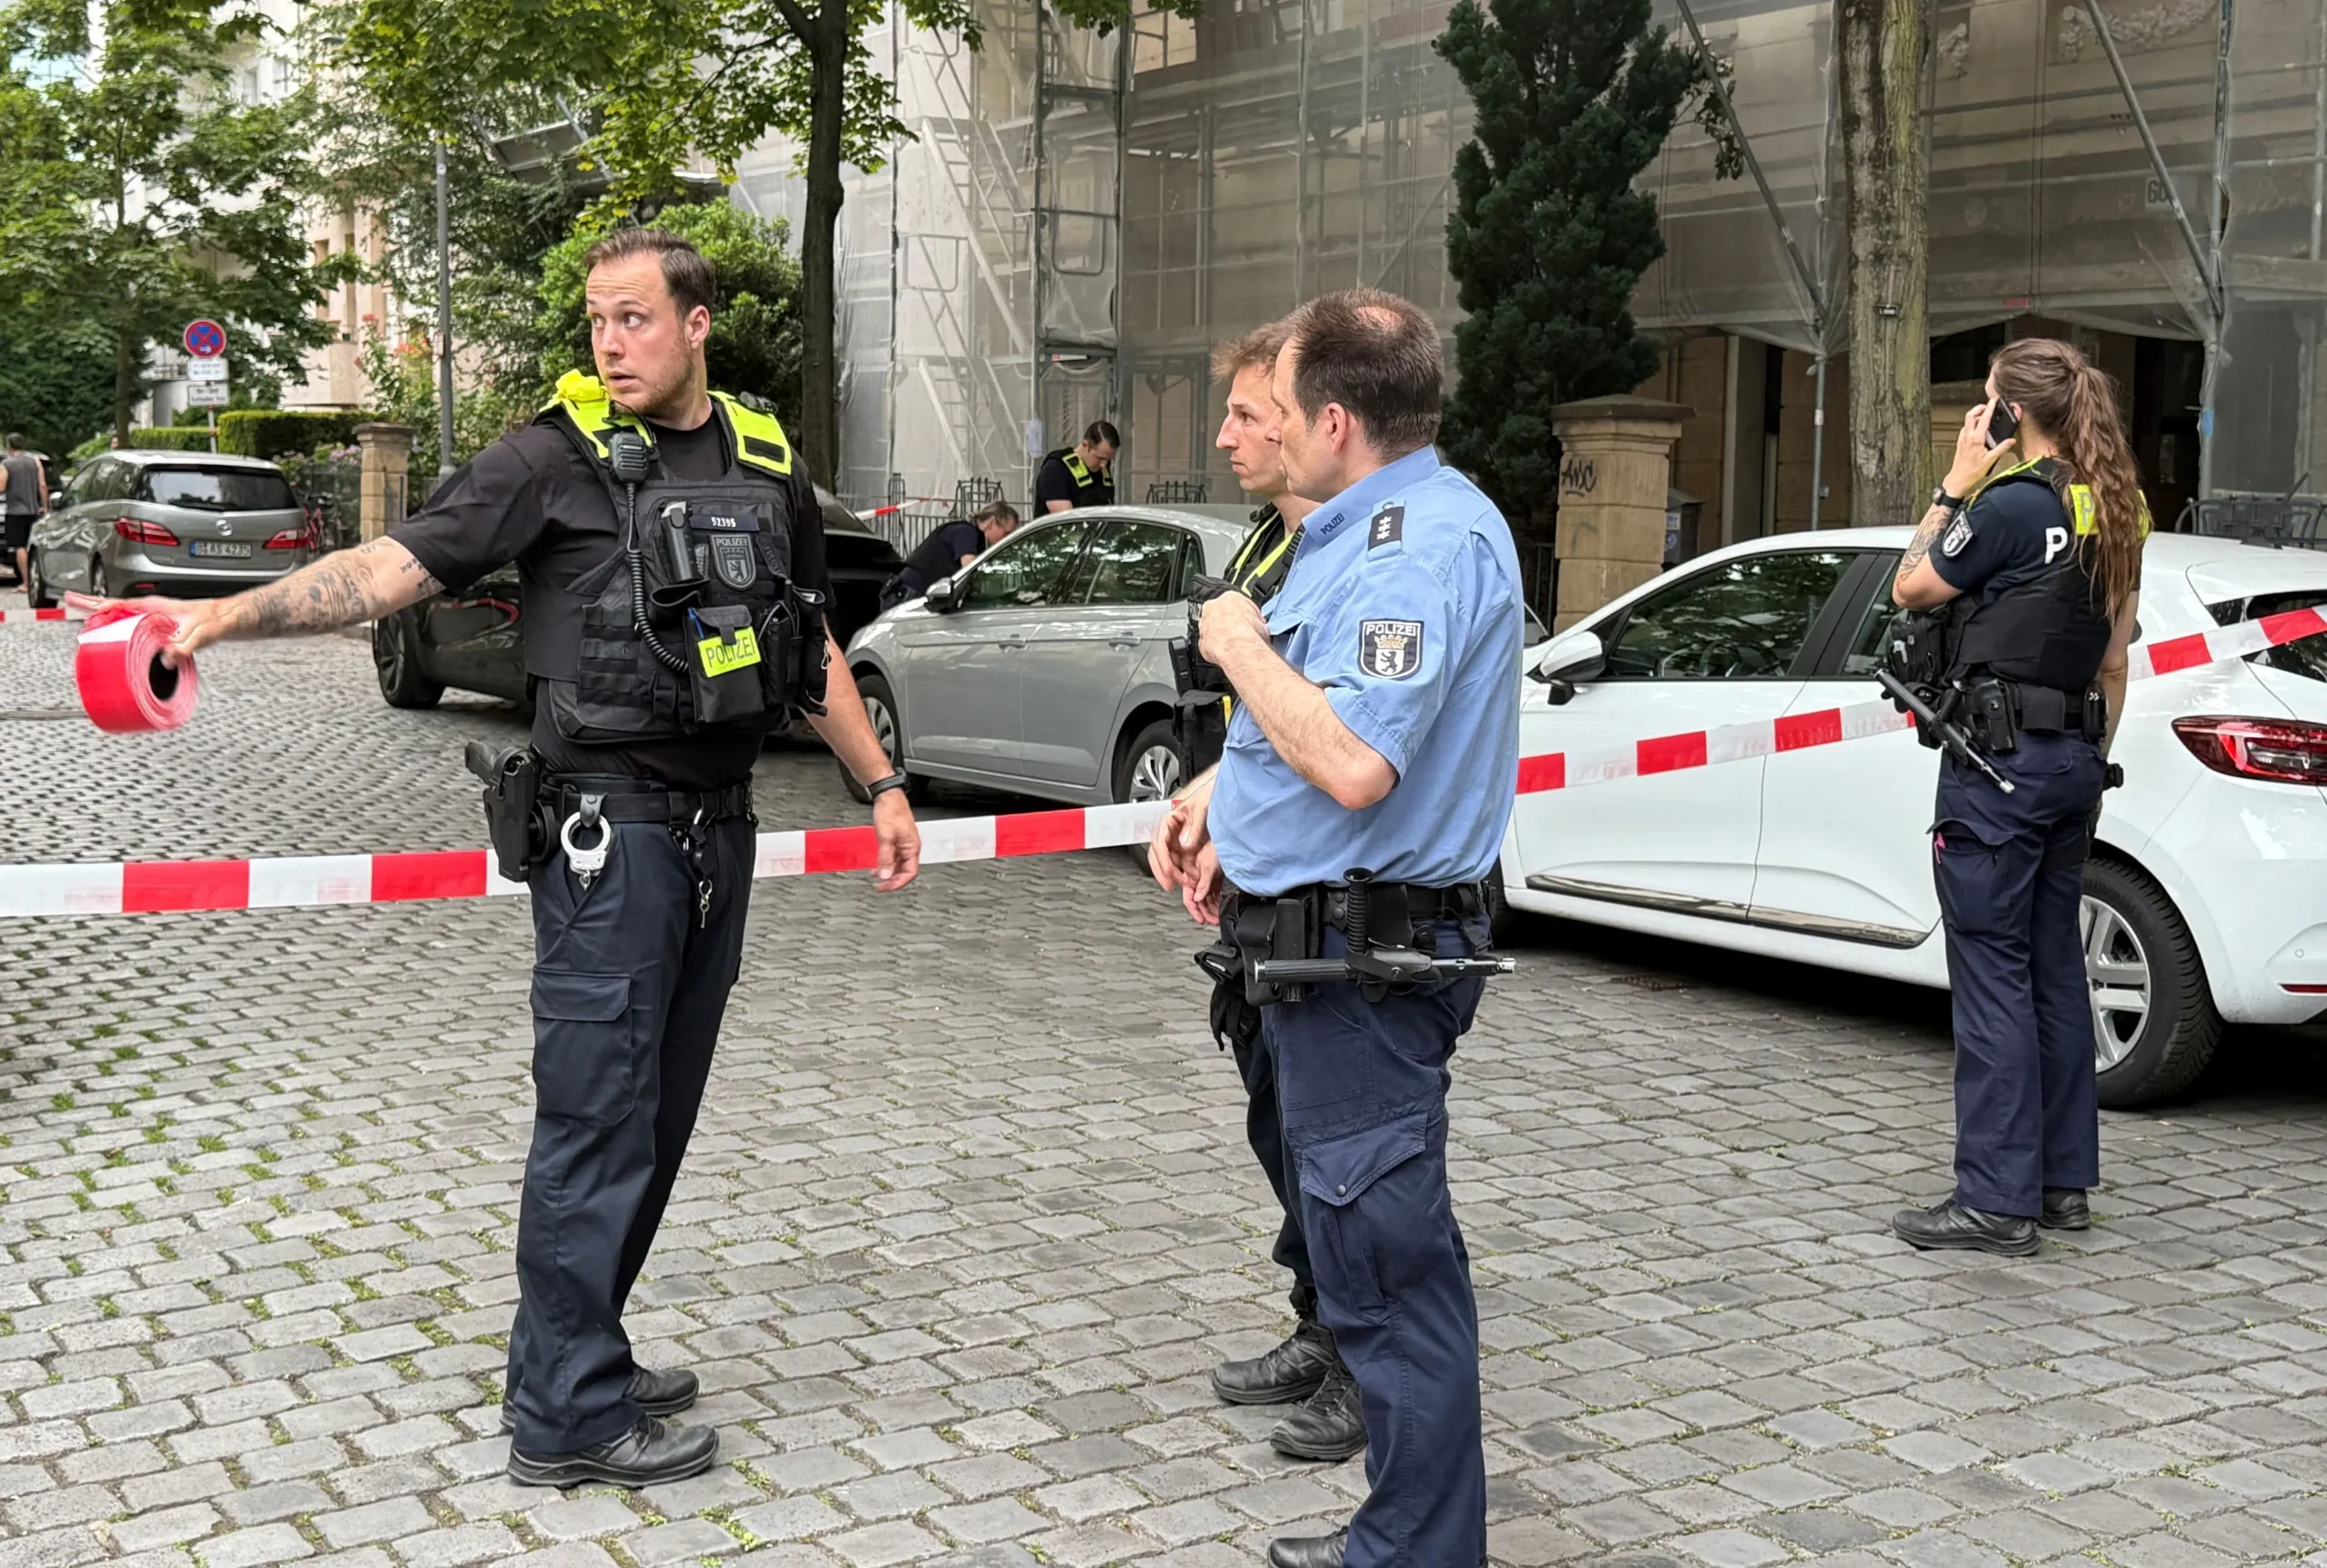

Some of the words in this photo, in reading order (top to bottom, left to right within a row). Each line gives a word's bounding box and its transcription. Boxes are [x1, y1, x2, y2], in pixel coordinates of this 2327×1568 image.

[711, 516, 736, 527] 52395
[1320, 513, 1345, 535] POLIZEI
[715, 538, 747, 546] POLIZEI
[1365, 624, 1417, 636] POLIZEI
[705, 633, 756, 668] POLIZEI
